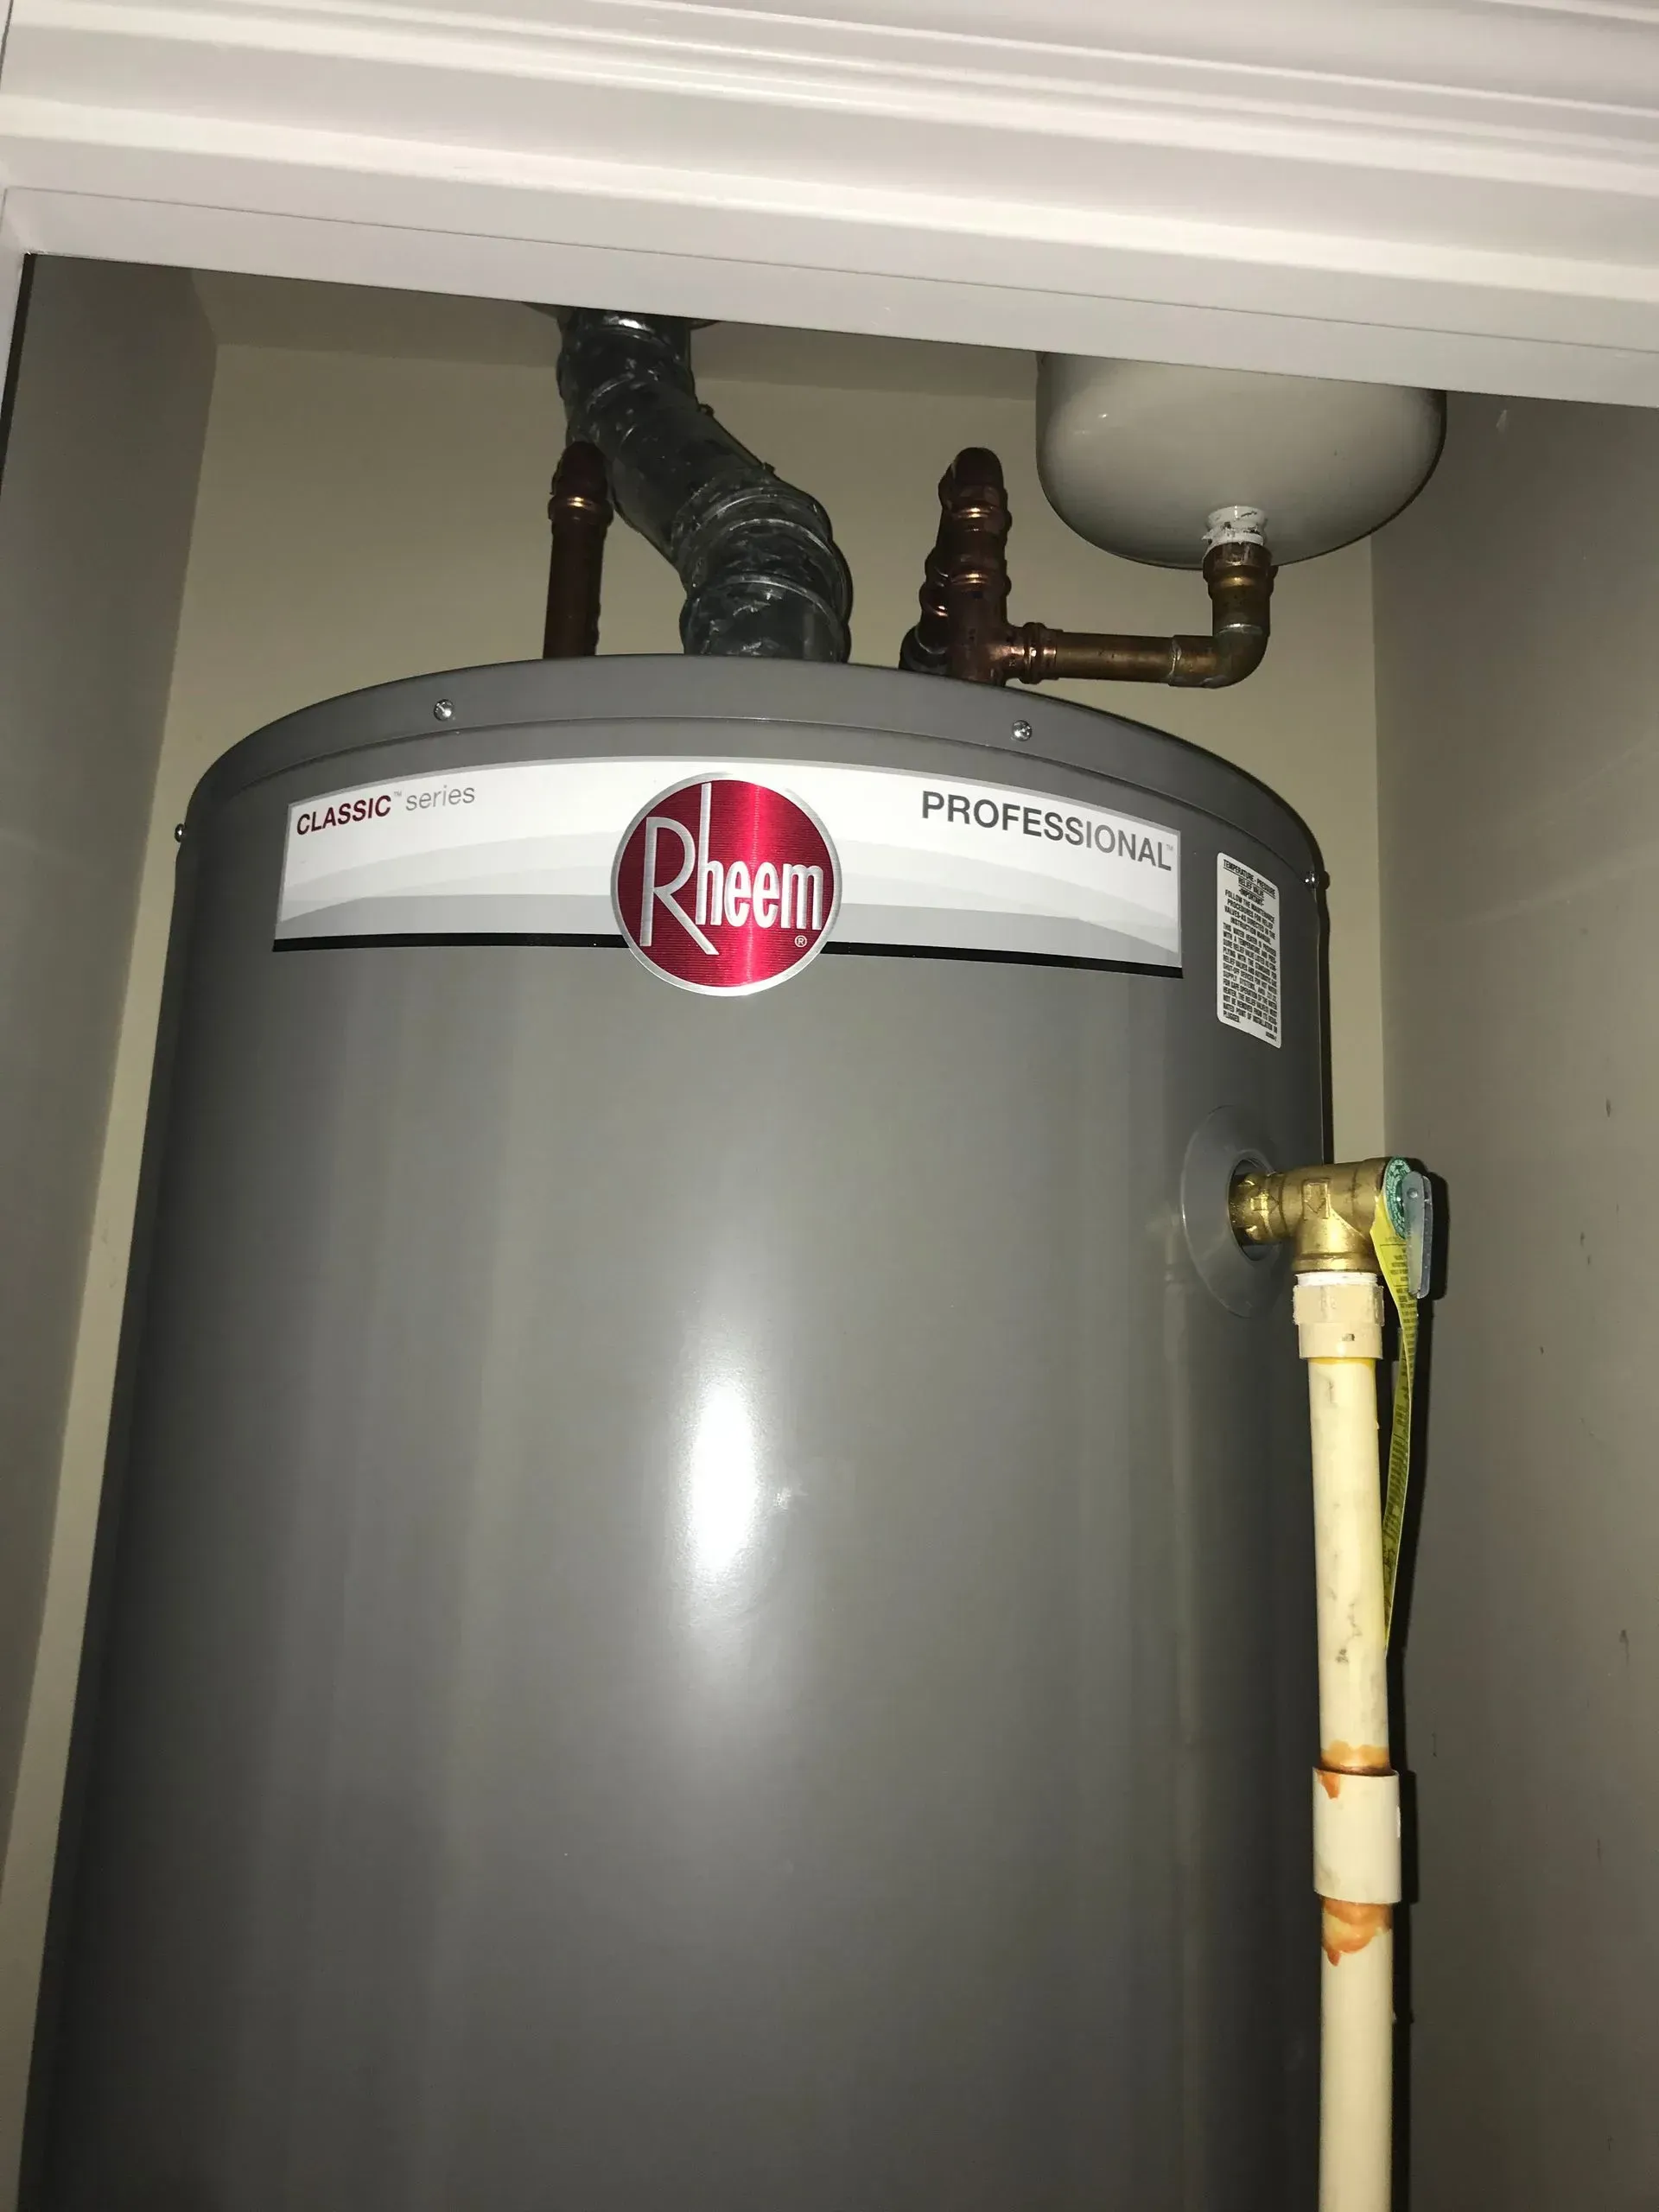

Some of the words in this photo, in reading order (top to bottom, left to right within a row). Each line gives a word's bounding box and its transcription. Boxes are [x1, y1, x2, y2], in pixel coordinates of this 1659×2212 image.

[405, 785, 475, 811] series
[639, 782, 824, 956] Rheem
[1225, 889, 1243, 903] FOLLOW
